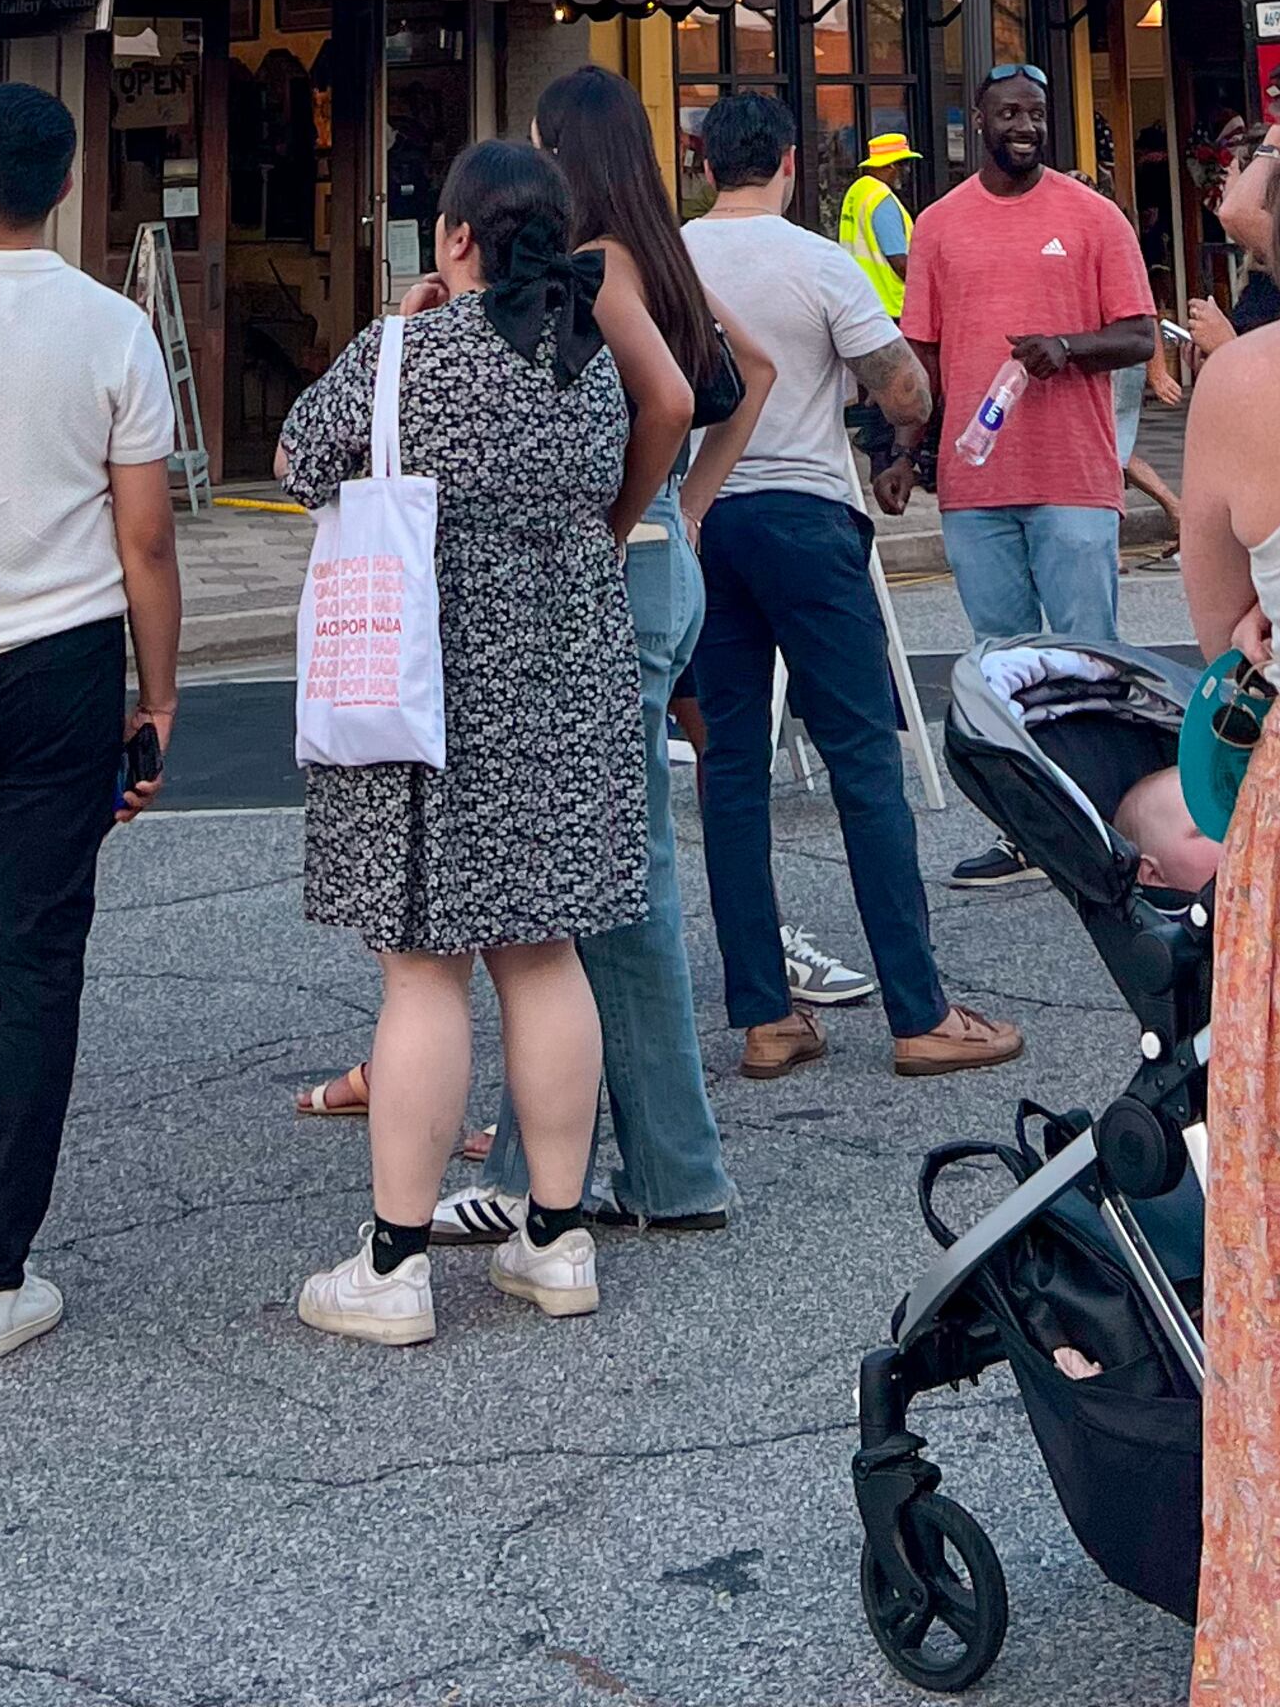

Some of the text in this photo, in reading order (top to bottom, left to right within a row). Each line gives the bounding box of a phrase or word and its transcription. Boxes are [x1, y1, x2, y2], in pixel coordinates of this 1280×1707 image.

[120, 69, 187, 96] OPEN
[341, 618, 368, 636] POR
[371, 616, 402, 634] NADA
